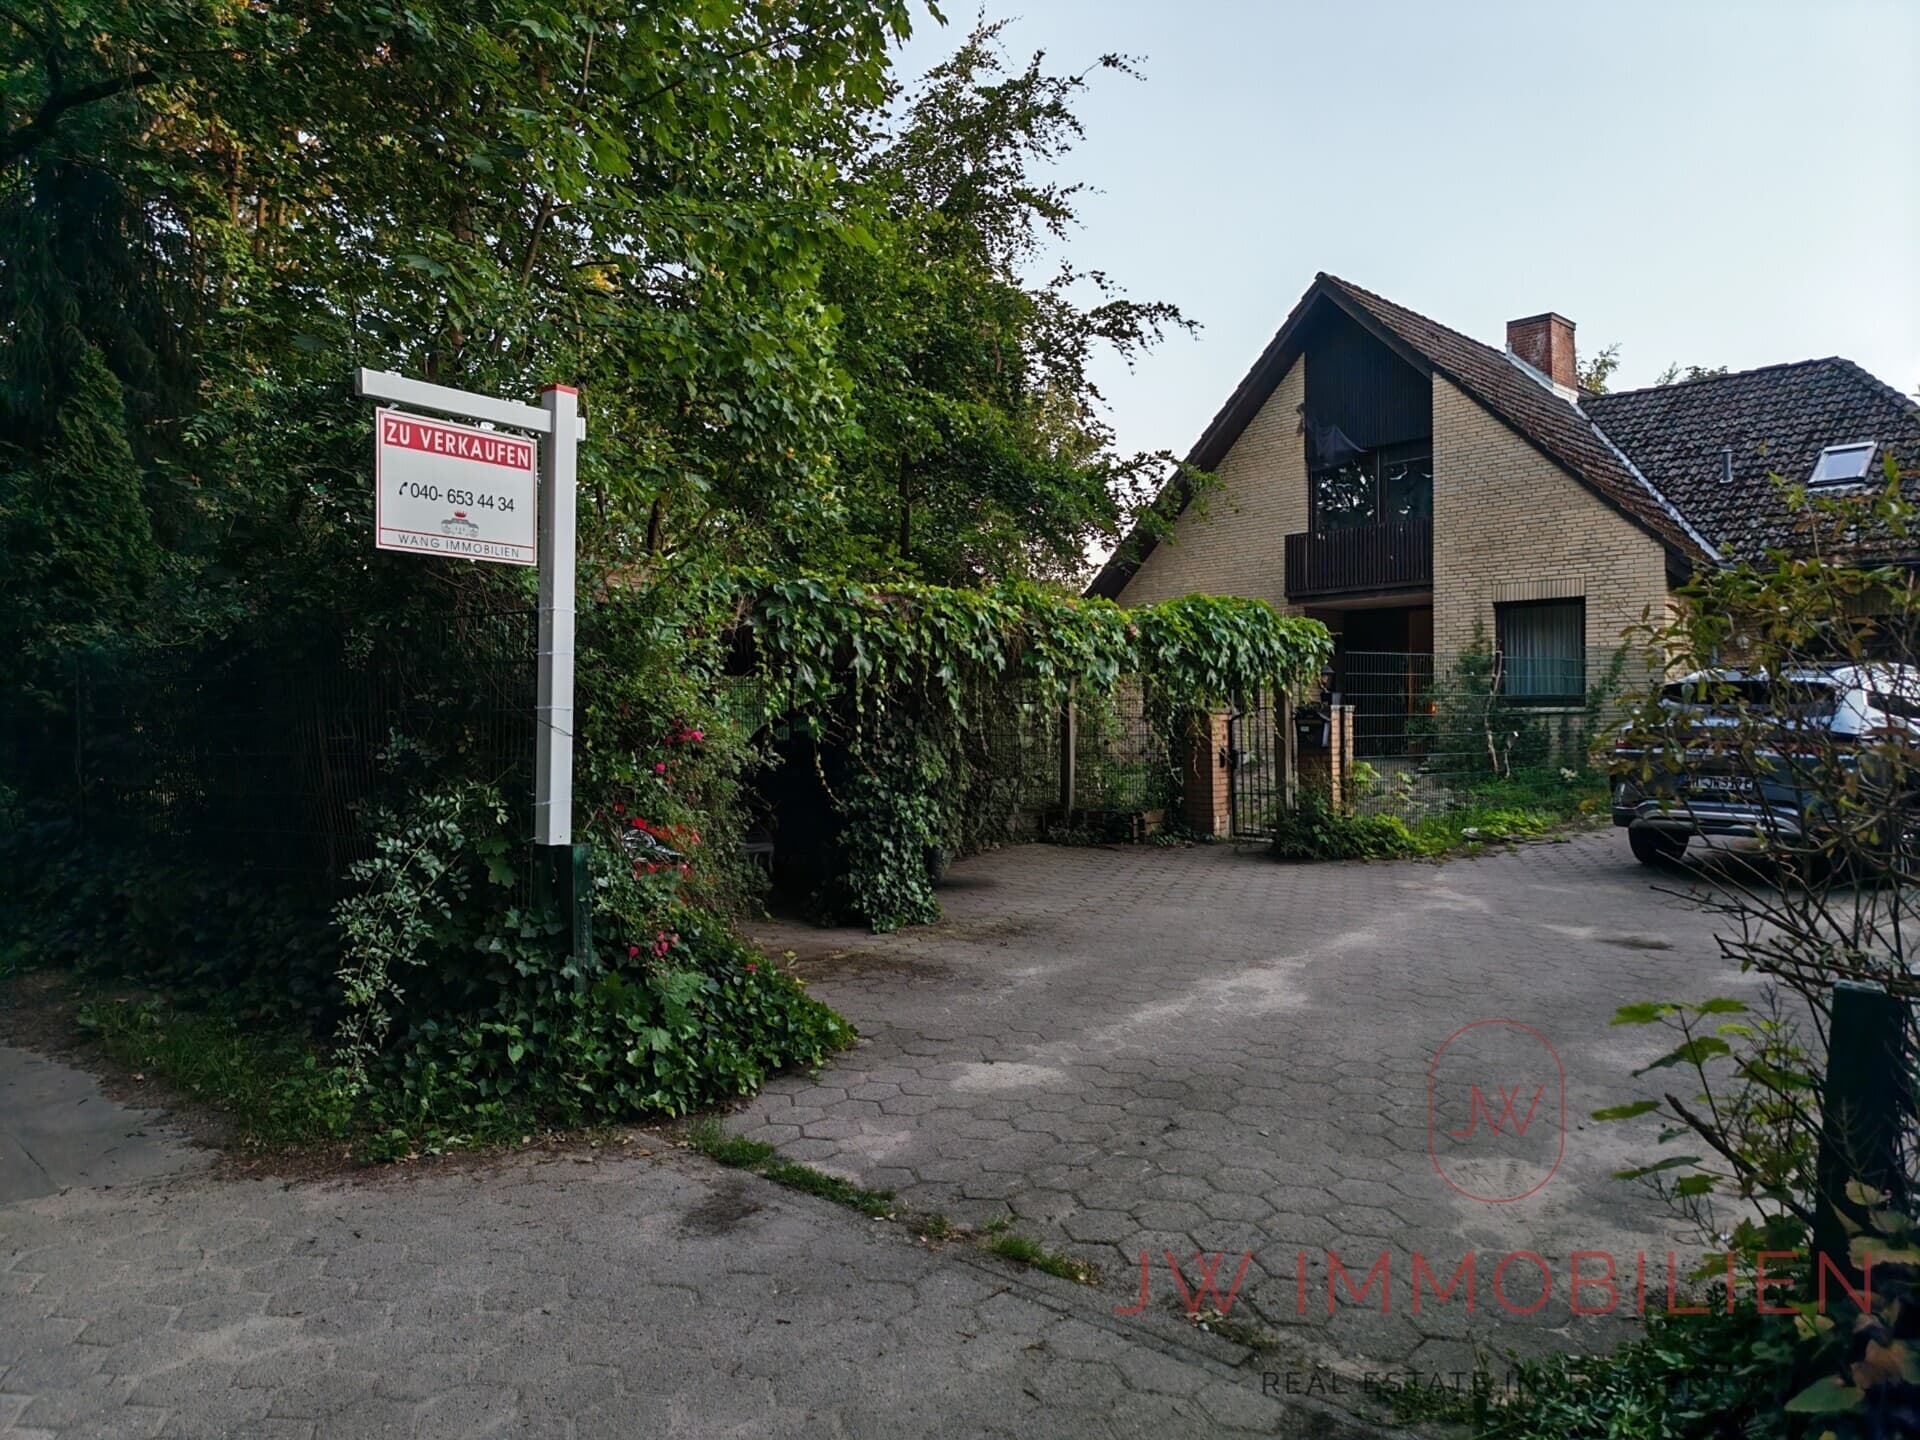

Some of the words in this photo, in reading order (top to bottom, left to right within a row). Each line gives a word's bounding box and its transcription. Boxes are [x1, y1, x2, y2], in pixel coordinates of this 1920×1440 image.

[386, 422, 410, 444] ZU
[420, 428, 530, 468] VERKAUFEN
[410, 483, 443, 501] 040-
[447, 489, 473, 506] 653
[477, 494, 494, 509] 44
[498, 497, 515, 512] 34
[398, 534, 440, 549] WANG
[446, 541, 519, 558] IMMOBILIEN
